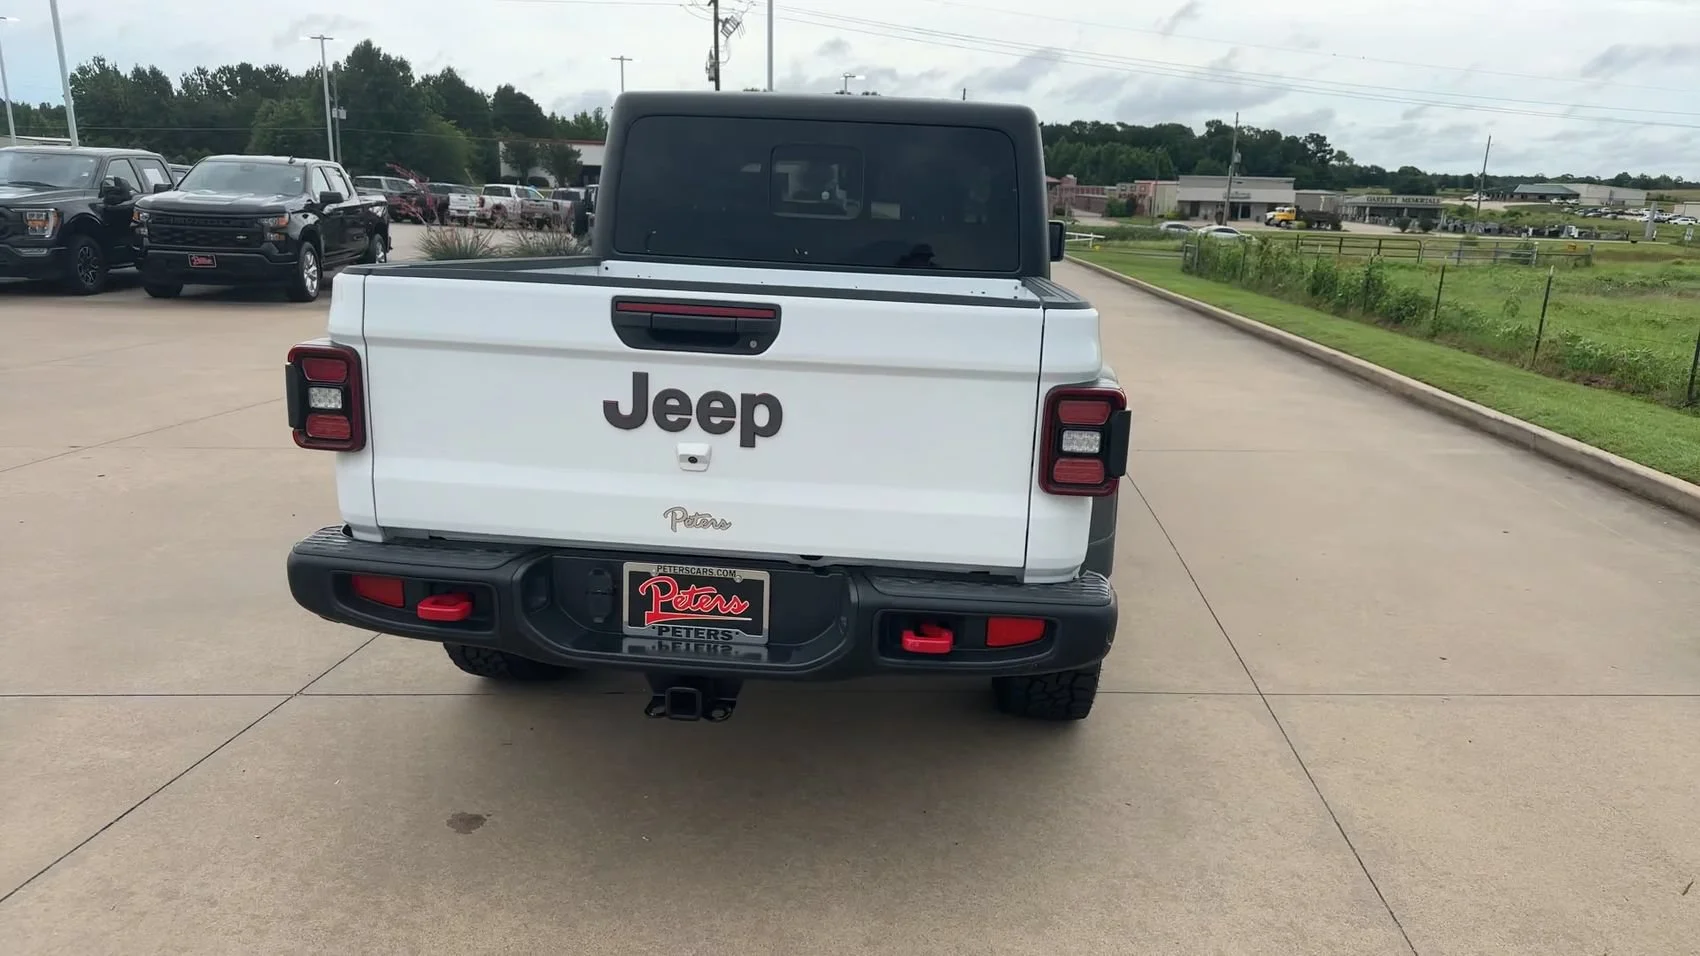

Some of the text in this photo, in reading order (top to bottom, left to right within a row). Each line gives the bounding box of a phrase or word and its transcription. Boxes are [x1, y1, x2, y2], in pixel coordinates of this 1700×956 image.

[602, 371, 783, 448] Jeep
[663, 506, 732, 533] Peters
[656, 565, 737, 578] PETERSCARS.COM
[639, 576, 751, 622] Peters
[657, 626, 734, 641] PETERS
